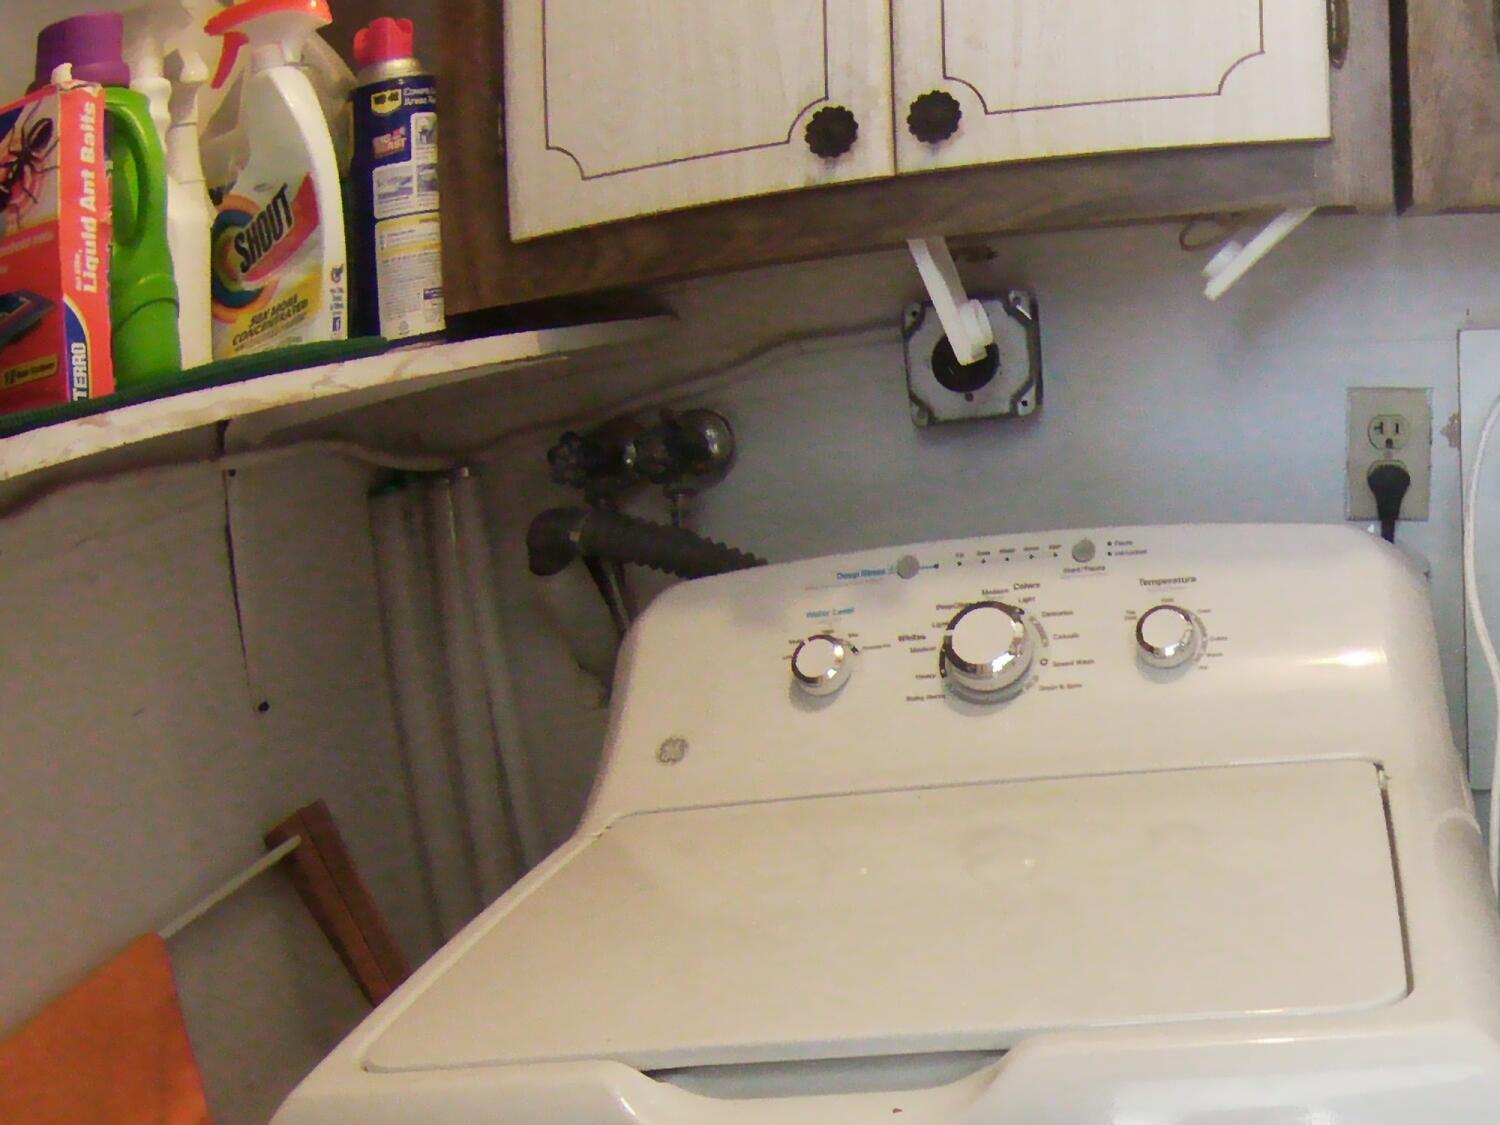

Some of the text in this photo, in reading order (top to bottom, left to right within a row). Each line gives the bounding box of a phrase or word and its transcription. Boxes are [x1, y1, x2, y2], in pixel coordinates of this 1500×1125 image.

[80, 101, 99, 294] Liquid Ant Baits
[234, 183, 294, 274] SHOUT
[71, 342, 88, 402] TERRO
